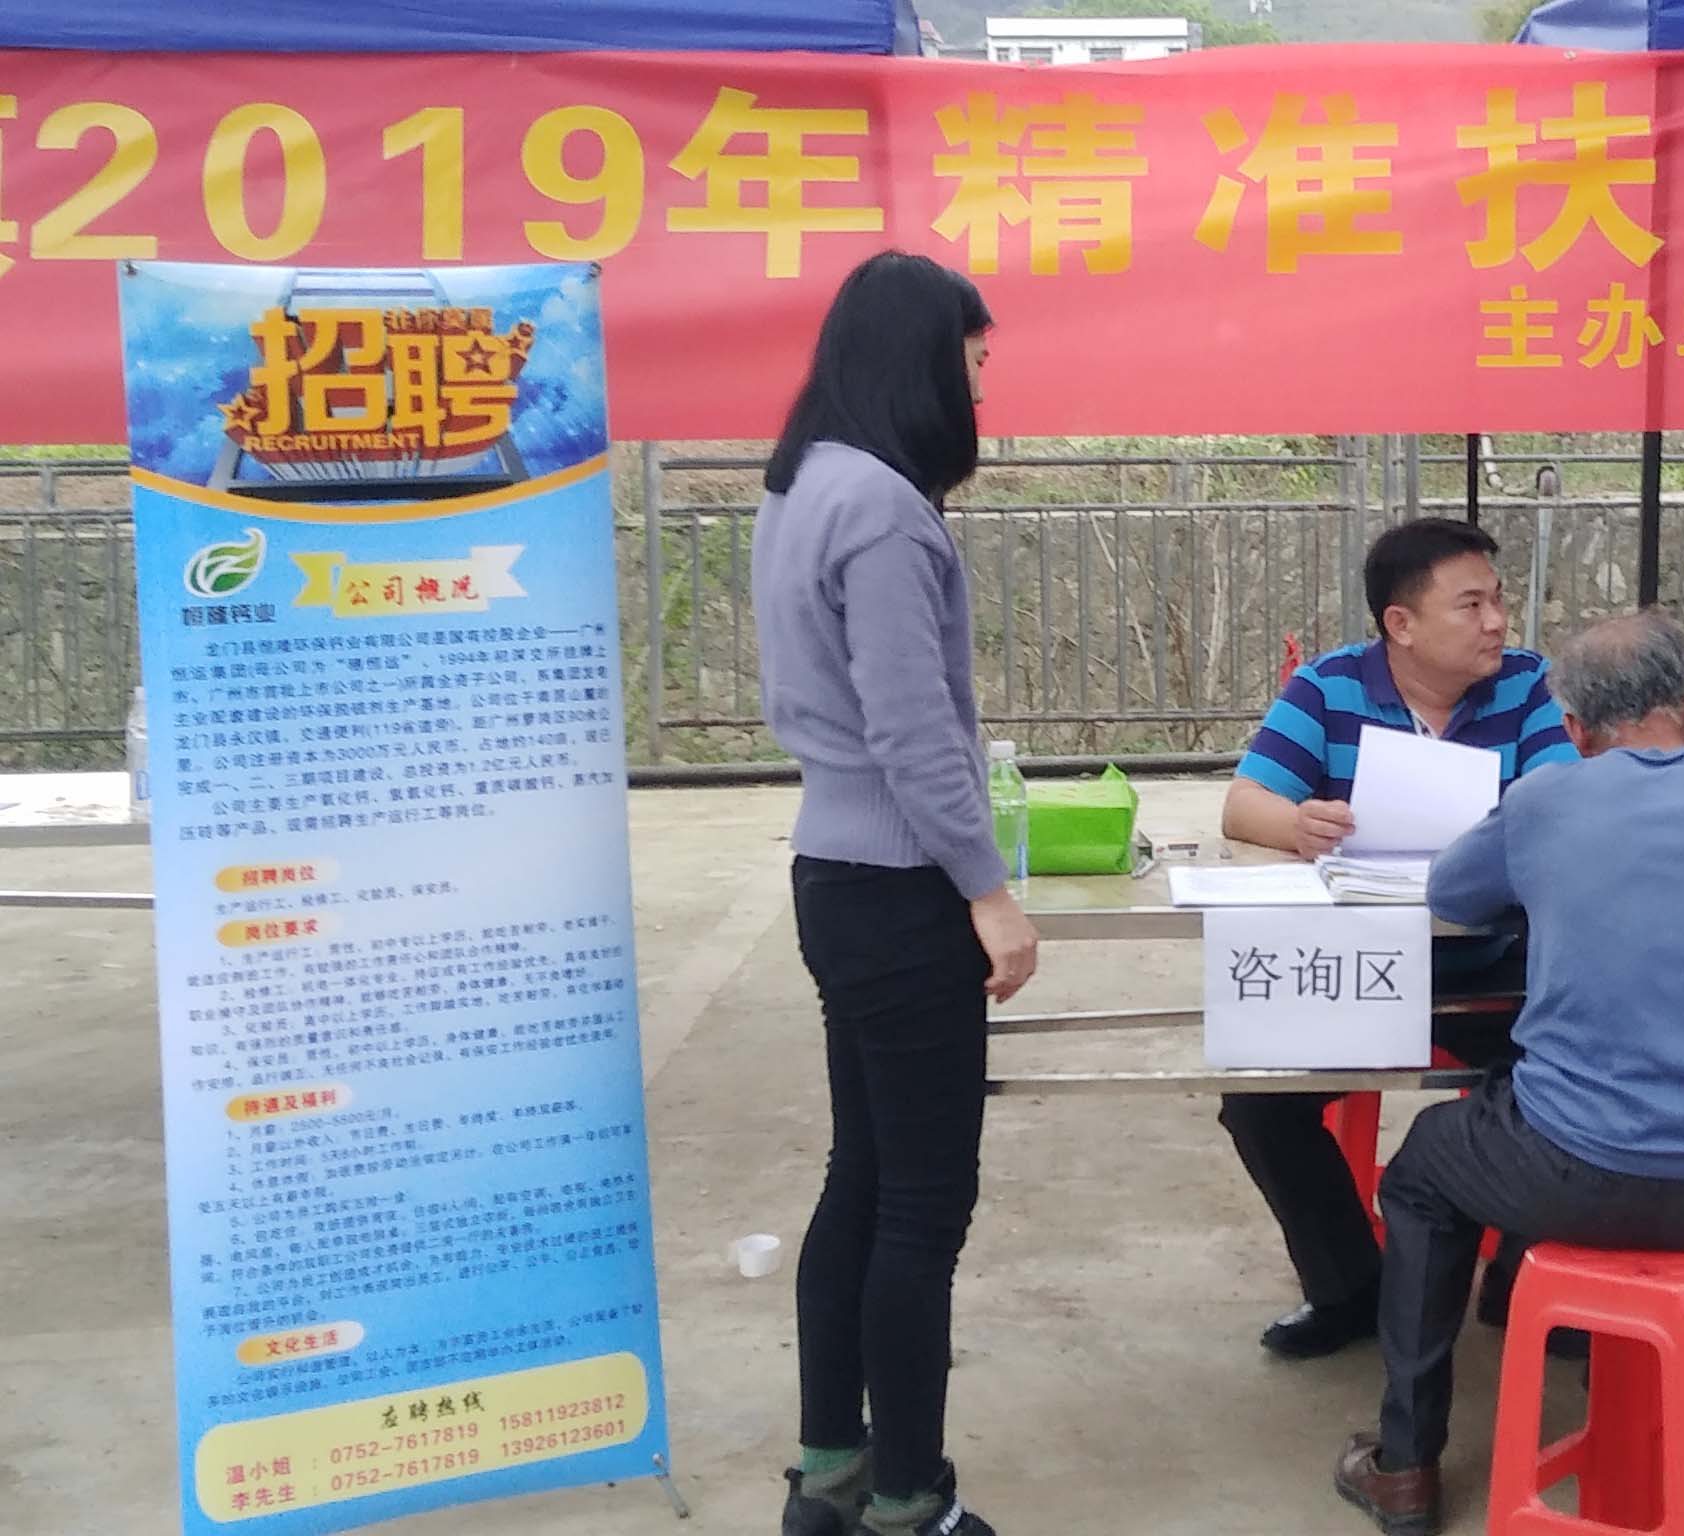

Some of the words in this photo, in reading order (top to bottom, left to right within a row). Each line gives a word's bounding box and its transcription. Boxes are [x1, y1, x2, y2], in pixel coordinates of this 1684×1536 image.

[251, 306, 519, 446] 招聘
[245, 431, 423, 453] RECRUITMENT
[347, 574, 481, 606] 公司概况
[181, 602, 277, 627] 恒隆钙业
[244, 918, 319, 940] 岗位要求
[1229, 945, 1404, 1002] 咨询区
[244, 1088, 337, 1116] 待遇及福利
[265, 1328, 339, 1357] 文化生活
[379, 1389, 486, 1430] 应聘热线
[329, 1420, 479, 1465] 0752-7617819
[499, 1391, 625, 1433] 15811923812
[331, 1446, 480, 1493] 0752-7617819
[500, 1417, 626, 1459] 13926123601
